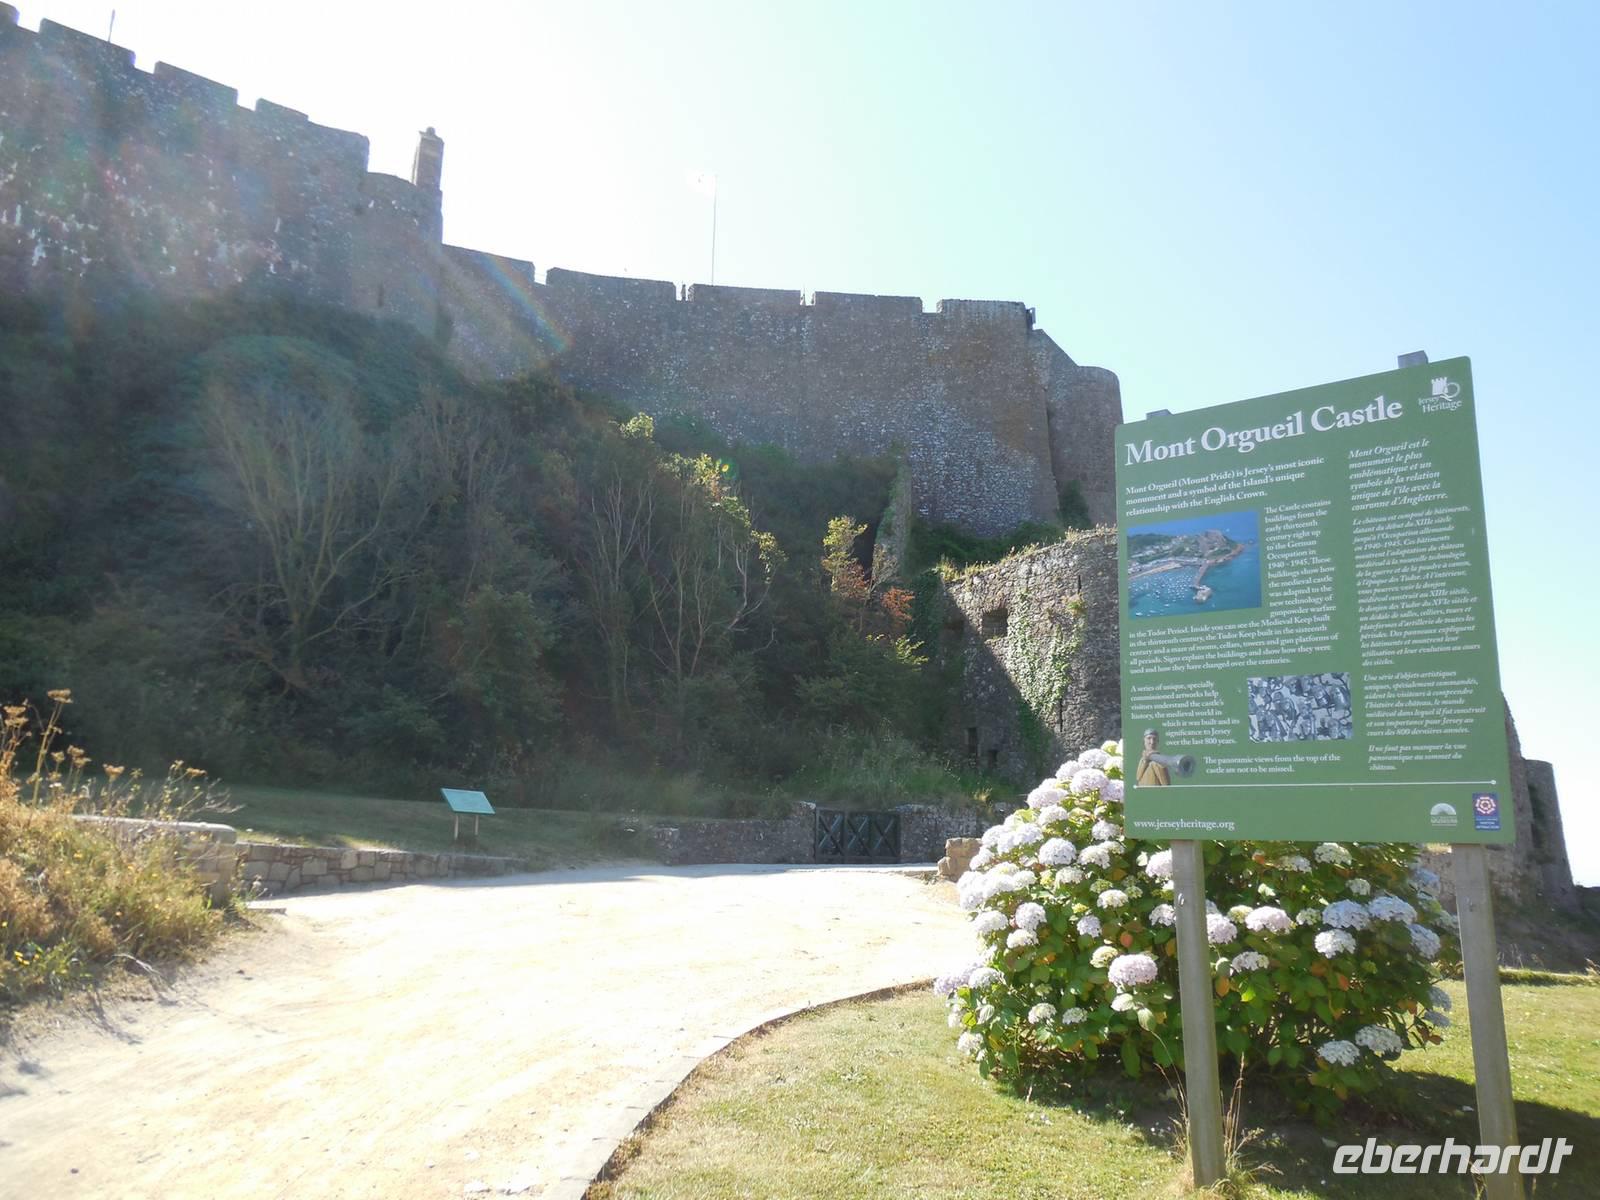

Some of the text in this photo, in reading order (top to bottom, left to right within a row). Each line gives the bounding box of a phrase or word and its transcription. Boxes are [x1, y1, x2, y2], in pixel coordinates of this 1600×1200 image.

[1423, 400, 1462, 413] Heritage
[1125, 395, 1403, 466] Mont Orgueil Castle
[1349, 449, 1372, 458] Mont
[1374, 442, 1407, 455] Orgueil
[1408, 441, 1420, 449] est
[1349, 456, 1393, 469] monument
[1404, 452, 1422, 463] plus
[1126, 486, 1147, 495] Mont
[1148, 480, 1177, 492] Orgueil
[1178, 476, 1208, 487] (Mount
[1210, 471, 1235, 481] Pride)
[1275, 462, 1296, 471] most
[1298, 457, 1324, 467] iconic
[1406, 471, 1440, 481] relation
[1126, 494, 1166, 505] monument
[1168, 489, 1182, 499] and
[1189, 484, 1217, 497] symbol
[1228, 481, 1241, 489] the
[1275, 472, 1305, 482] unique
[1351, 491, 1379, 501] unique
[1411, 484, 1430, 492] avec
[1126, 491, 1267, 516] relationship with the English Crown.
[1264, 506, 1277, 514] The
[1278, 503, 1300, 512] Castle
[1352, 501, 1389, 511] couronne
[1265, 524, 1281, 533] early
[1266, 534, 1291, 542] century
[1293, 530, 1310, 539] right
[1281, 577, 1312, 586] medieval
[1313, 575, 1332, 583] castle
[1285, 596, 1322, 605] technology
[1261, 618, 1293, 626] Medieval
[1313, 614, 1330, 622] built
[1239, 631, 1256, 639] Keep
[1266, 637, 1279, 645] and
[1295, 635, 1329, 645] platforms
[1187, 681, 1214, 690] specially
[1211, 728, 1231, 736] Jersey
[1218, 757, 1253, 766] panoramic
[1293, 754, 1305, 762] the
[1305, 756, 1319, 764] top
[1328, 753, 1340, 761] the
[1268, 765, 1294, 773] missed.
[1134, 819, 1235, 831] www.jerseyheritage.org
